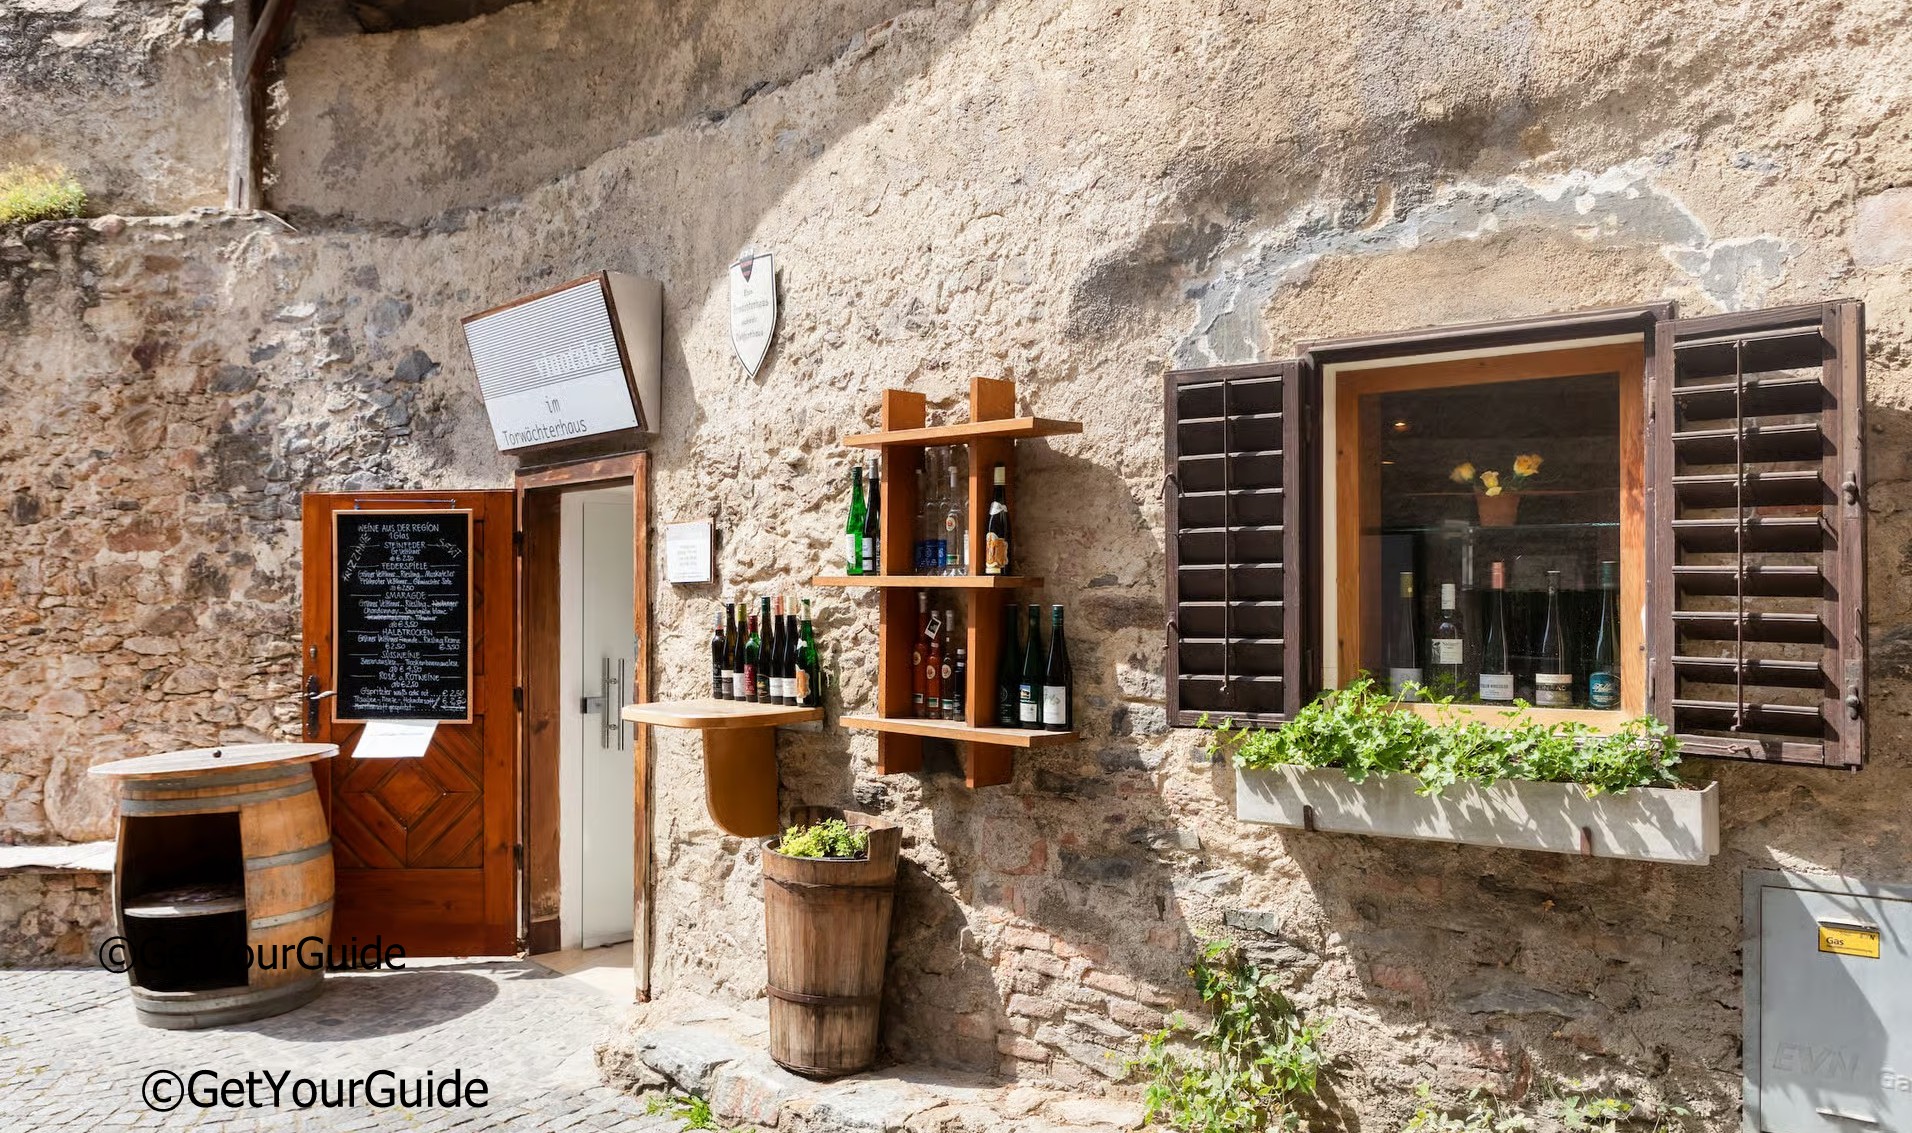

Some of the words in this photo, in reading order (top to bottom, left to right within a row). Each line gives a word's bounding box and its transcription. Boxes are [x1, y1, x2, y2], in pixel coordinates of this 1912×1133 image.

[544, 396, 561, 414] im
[502, 418, 588, 447] Torwächterhaus
[397, 523, 411, 532] DER
[1826, 936, 1845, 946] Gas
